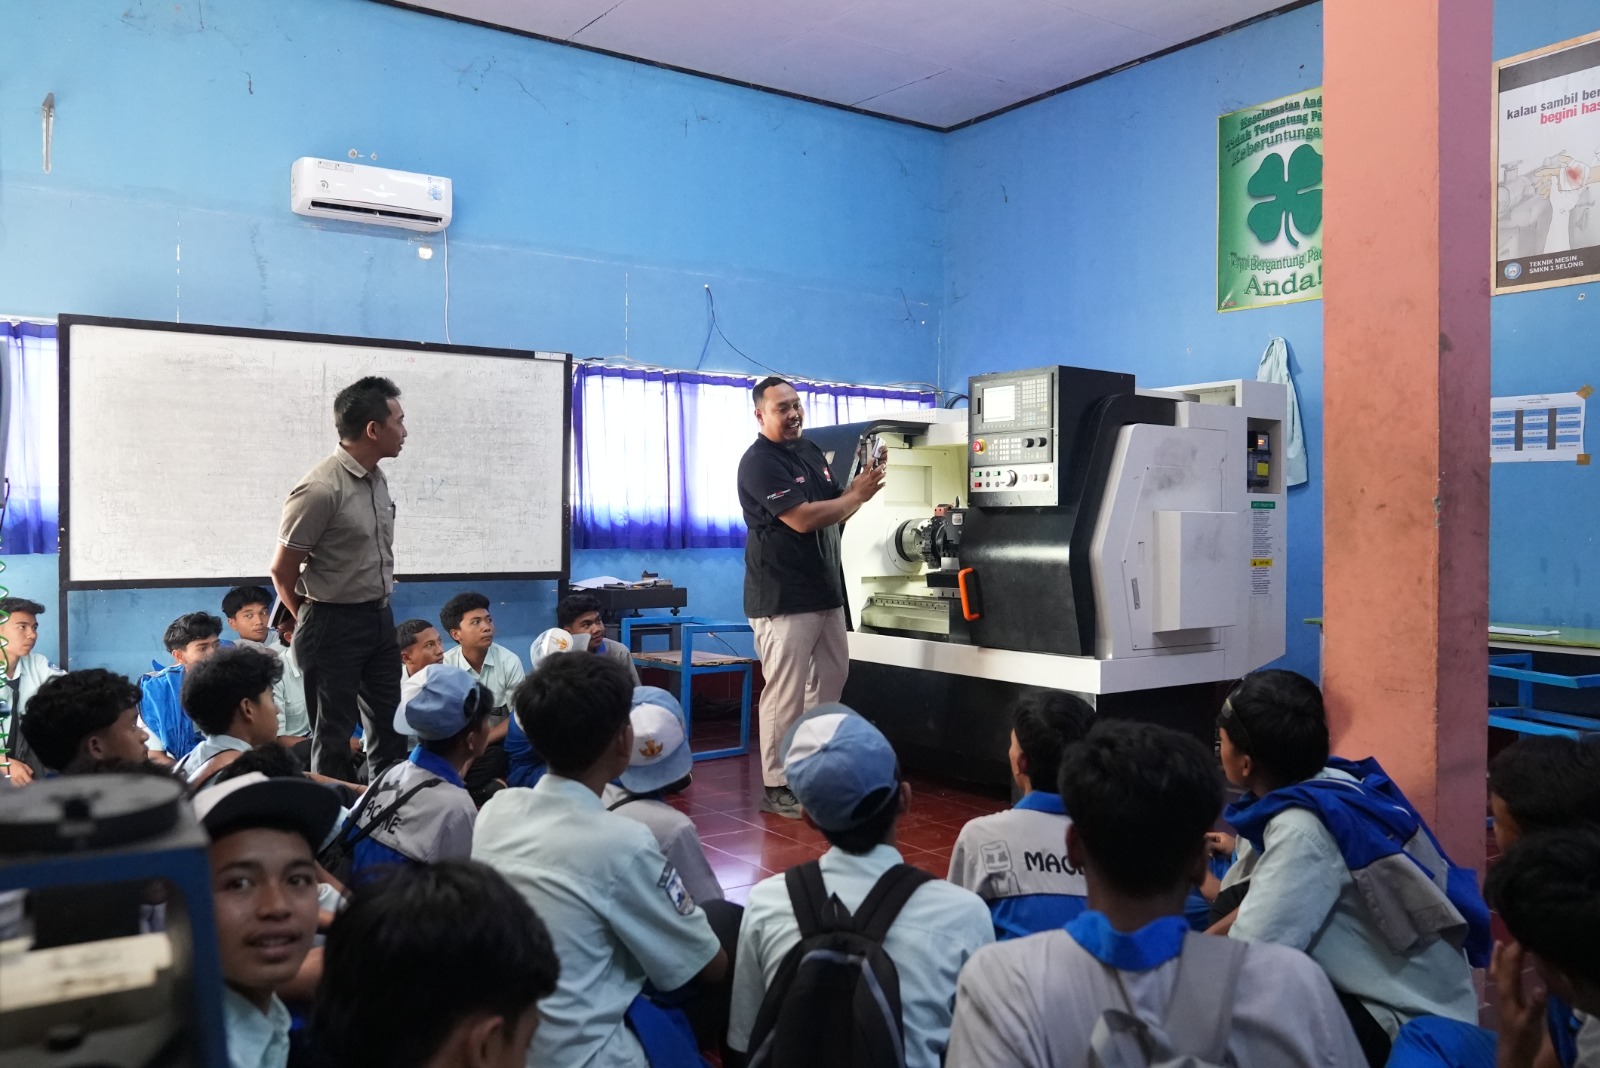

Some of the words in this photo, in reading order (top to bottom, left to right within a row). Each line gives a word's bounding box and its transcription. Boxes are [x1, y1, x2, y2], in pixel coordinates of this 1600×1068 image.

[1240, 101, 1300, 130] Keselamatan
[1507, 105, 1537, 120] kalau
[1540, 92, 1578, 112] sambil
[1540, 105, 1578, 124] begini
[1254, 113, 1308, 136] Tergantung
[1231, 127, 1322, 167] Keberuntunga
[1250, 254, 1305, 274] Bergantung
[1529, 259, 1553, 268] TEKNIK
[1554, 255, 1578, 264] MESIN
[1529, 265, 1549, 274] SMKN
[1555, 260, 1584, 270] SELONG
[1024, 851, 1084, 876] MAC
